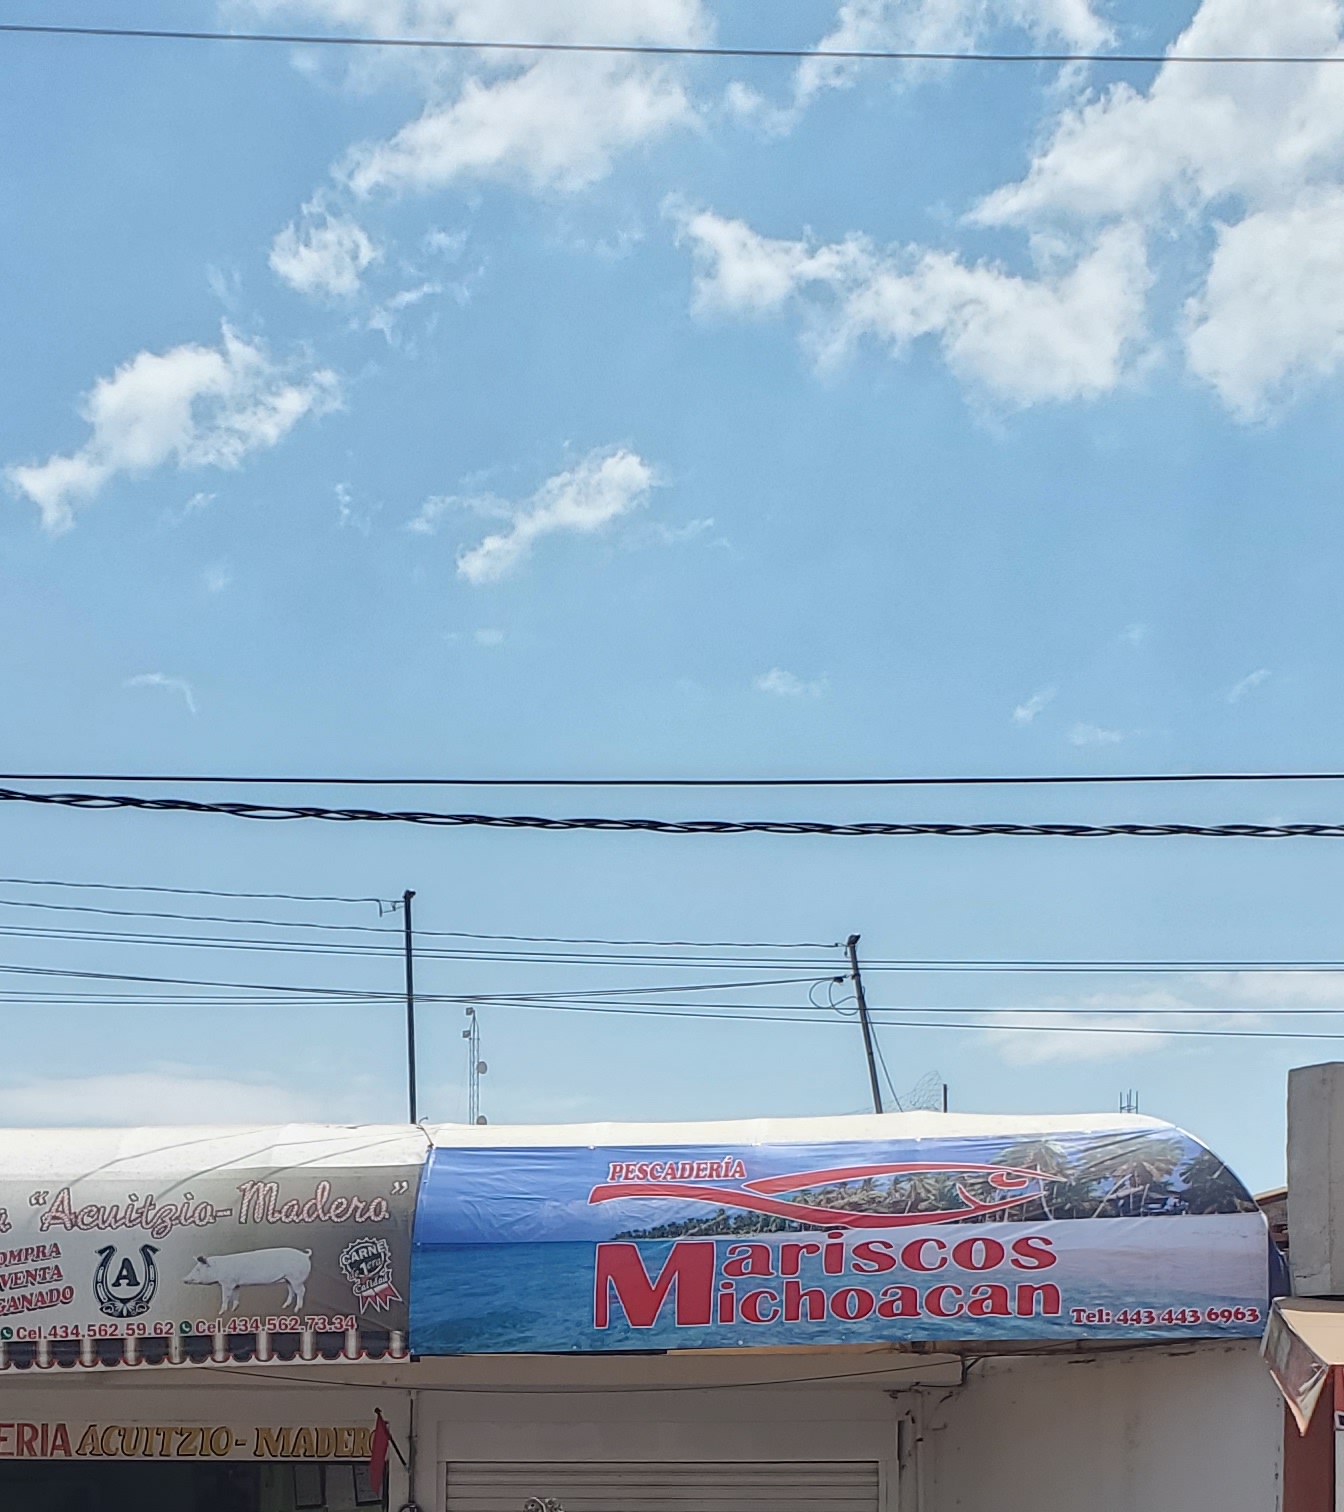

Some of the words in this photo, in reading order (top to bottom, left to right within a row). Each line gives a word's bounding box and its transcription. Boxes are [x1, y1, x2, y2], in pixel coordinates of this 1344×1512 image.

[608, 1155, 747, 1183] PESCADERÍA
[342, 1240, 386, 1265] CARNE
[111, 1257, 141, 1287] A
[355, 1273, 389, 1293] Calidad
[594, 1230, 1059, 1328] Mariscos
[1070, 1306, 1112, 1325] Tel:
[1115, 1307, 1156, 1327] 443
[1160, 1306, 1201, 1327] 443
[1206, 1305, 1261, 1325] 6963
